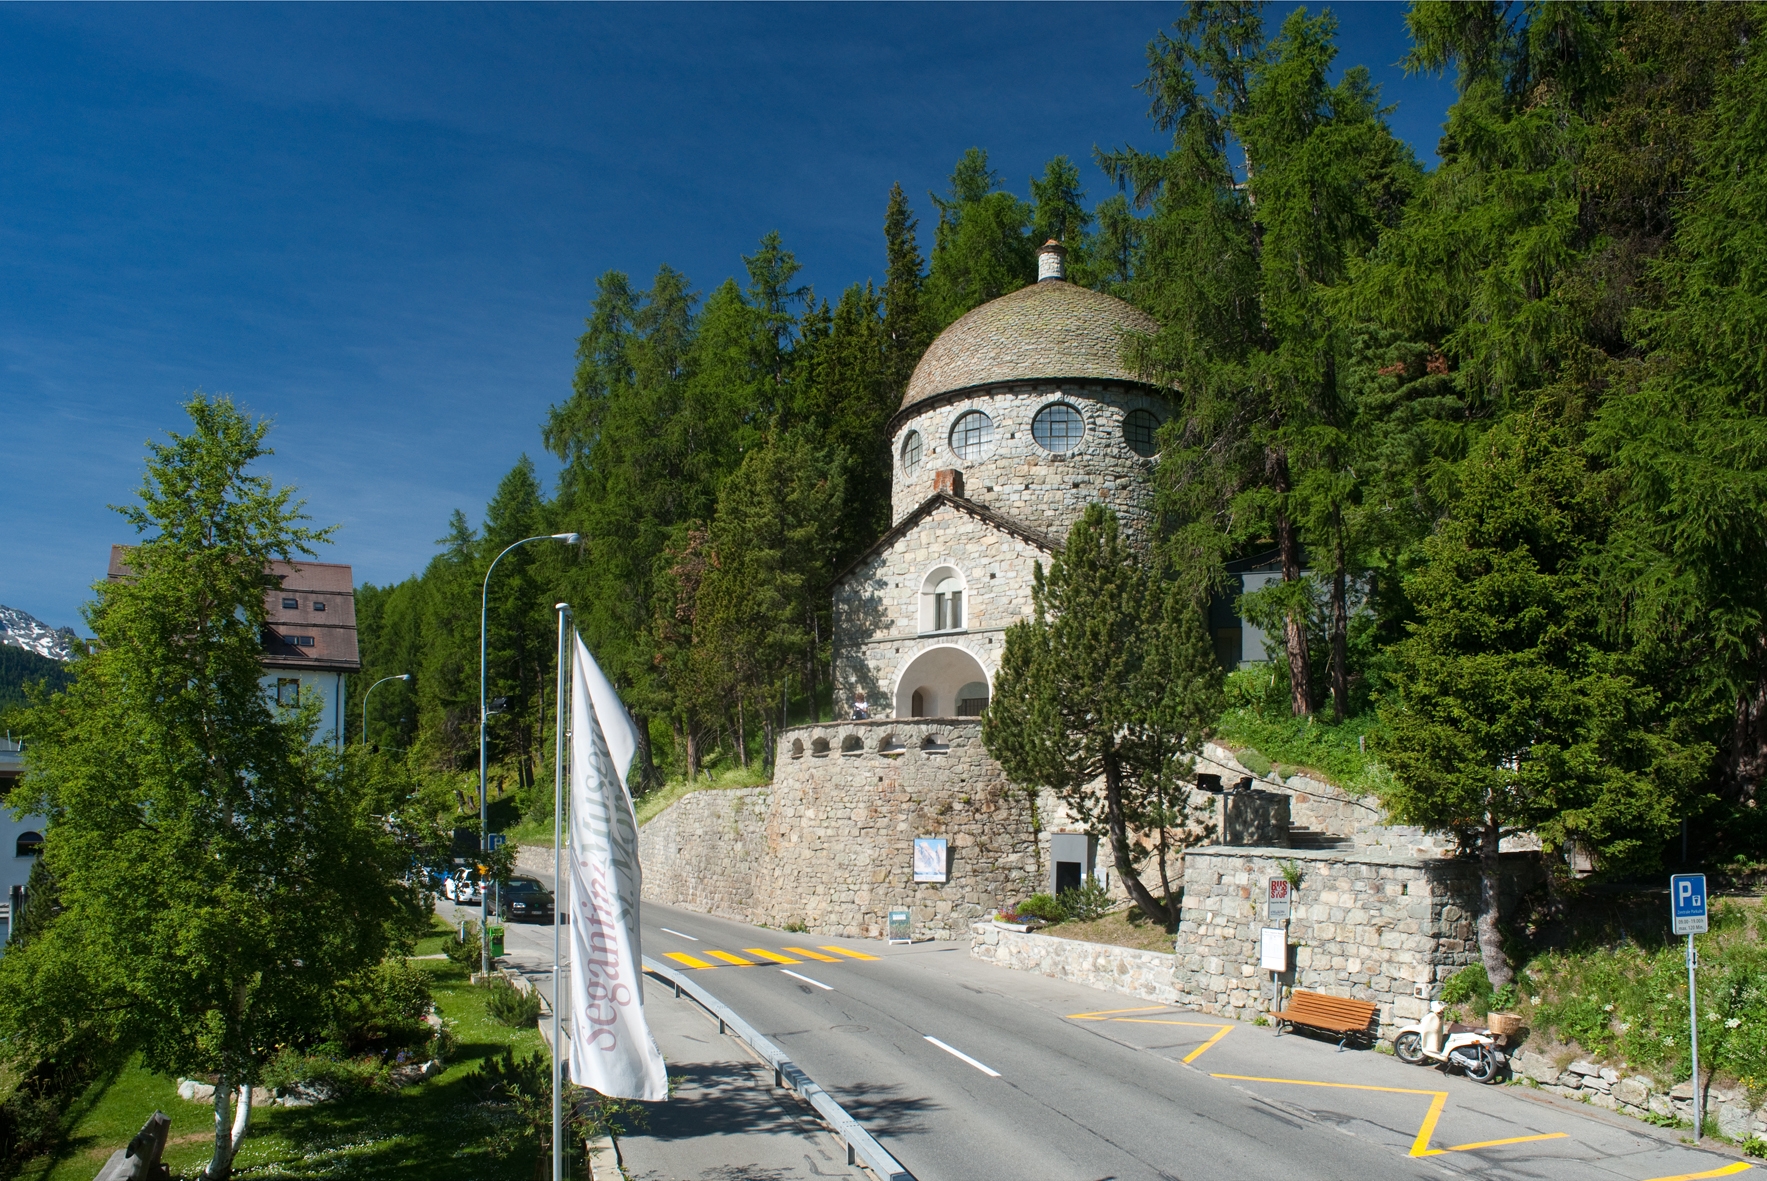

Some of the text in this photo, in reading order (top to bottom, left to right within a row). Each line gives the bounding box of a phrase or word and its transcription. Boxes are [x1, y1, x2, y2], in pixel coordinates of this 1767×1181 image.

[1271, 880, 1287, 891] BUS
[1270, 890, 1287, 899] STOP
[1679, 881, 1692, 906] P
